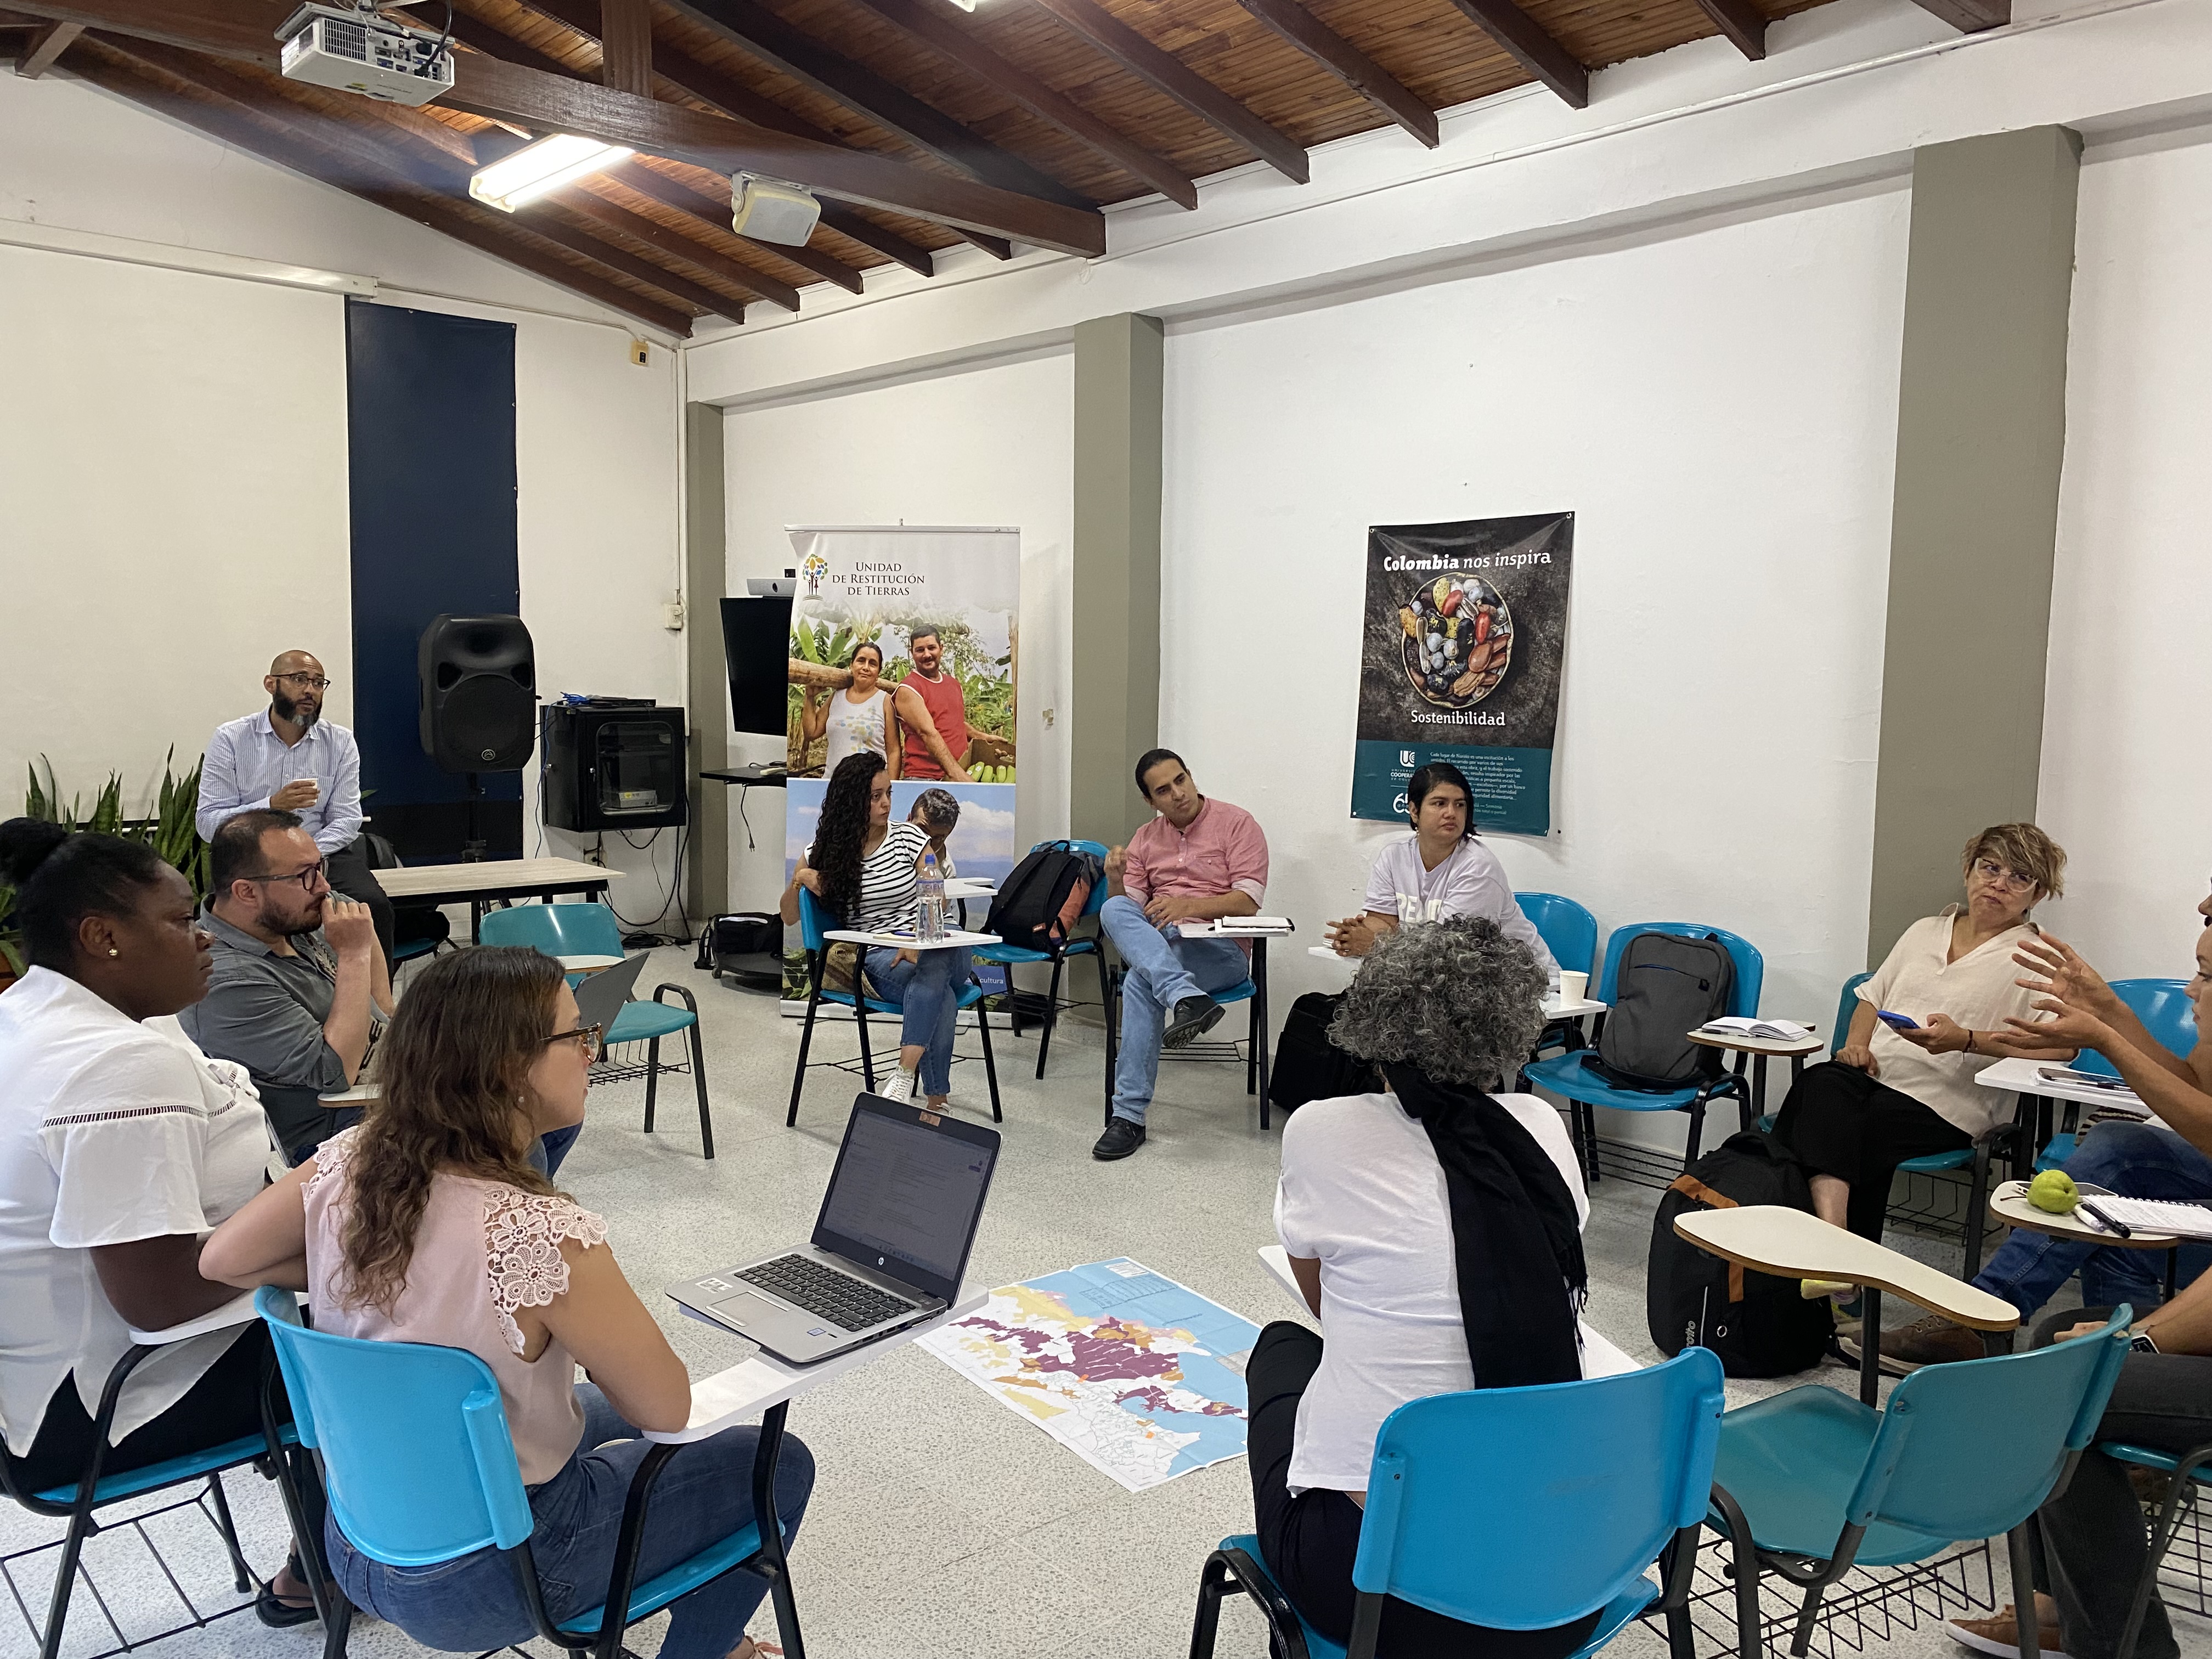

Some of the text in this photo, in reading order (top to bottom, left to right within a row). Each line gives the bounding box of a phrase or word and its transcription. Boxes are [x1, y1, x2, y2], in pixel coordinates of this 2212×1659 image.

[1383, 549, 1552, 572] Colombia nos inspira
[855, 562, 901, 572] UNIDAD
[832, 573, 924, 584] DE RESTITUCIÓN
[847, 585, 910, 596] DE TIERRAS
[1411, 709, 1506, 726] Sostenibilidad
